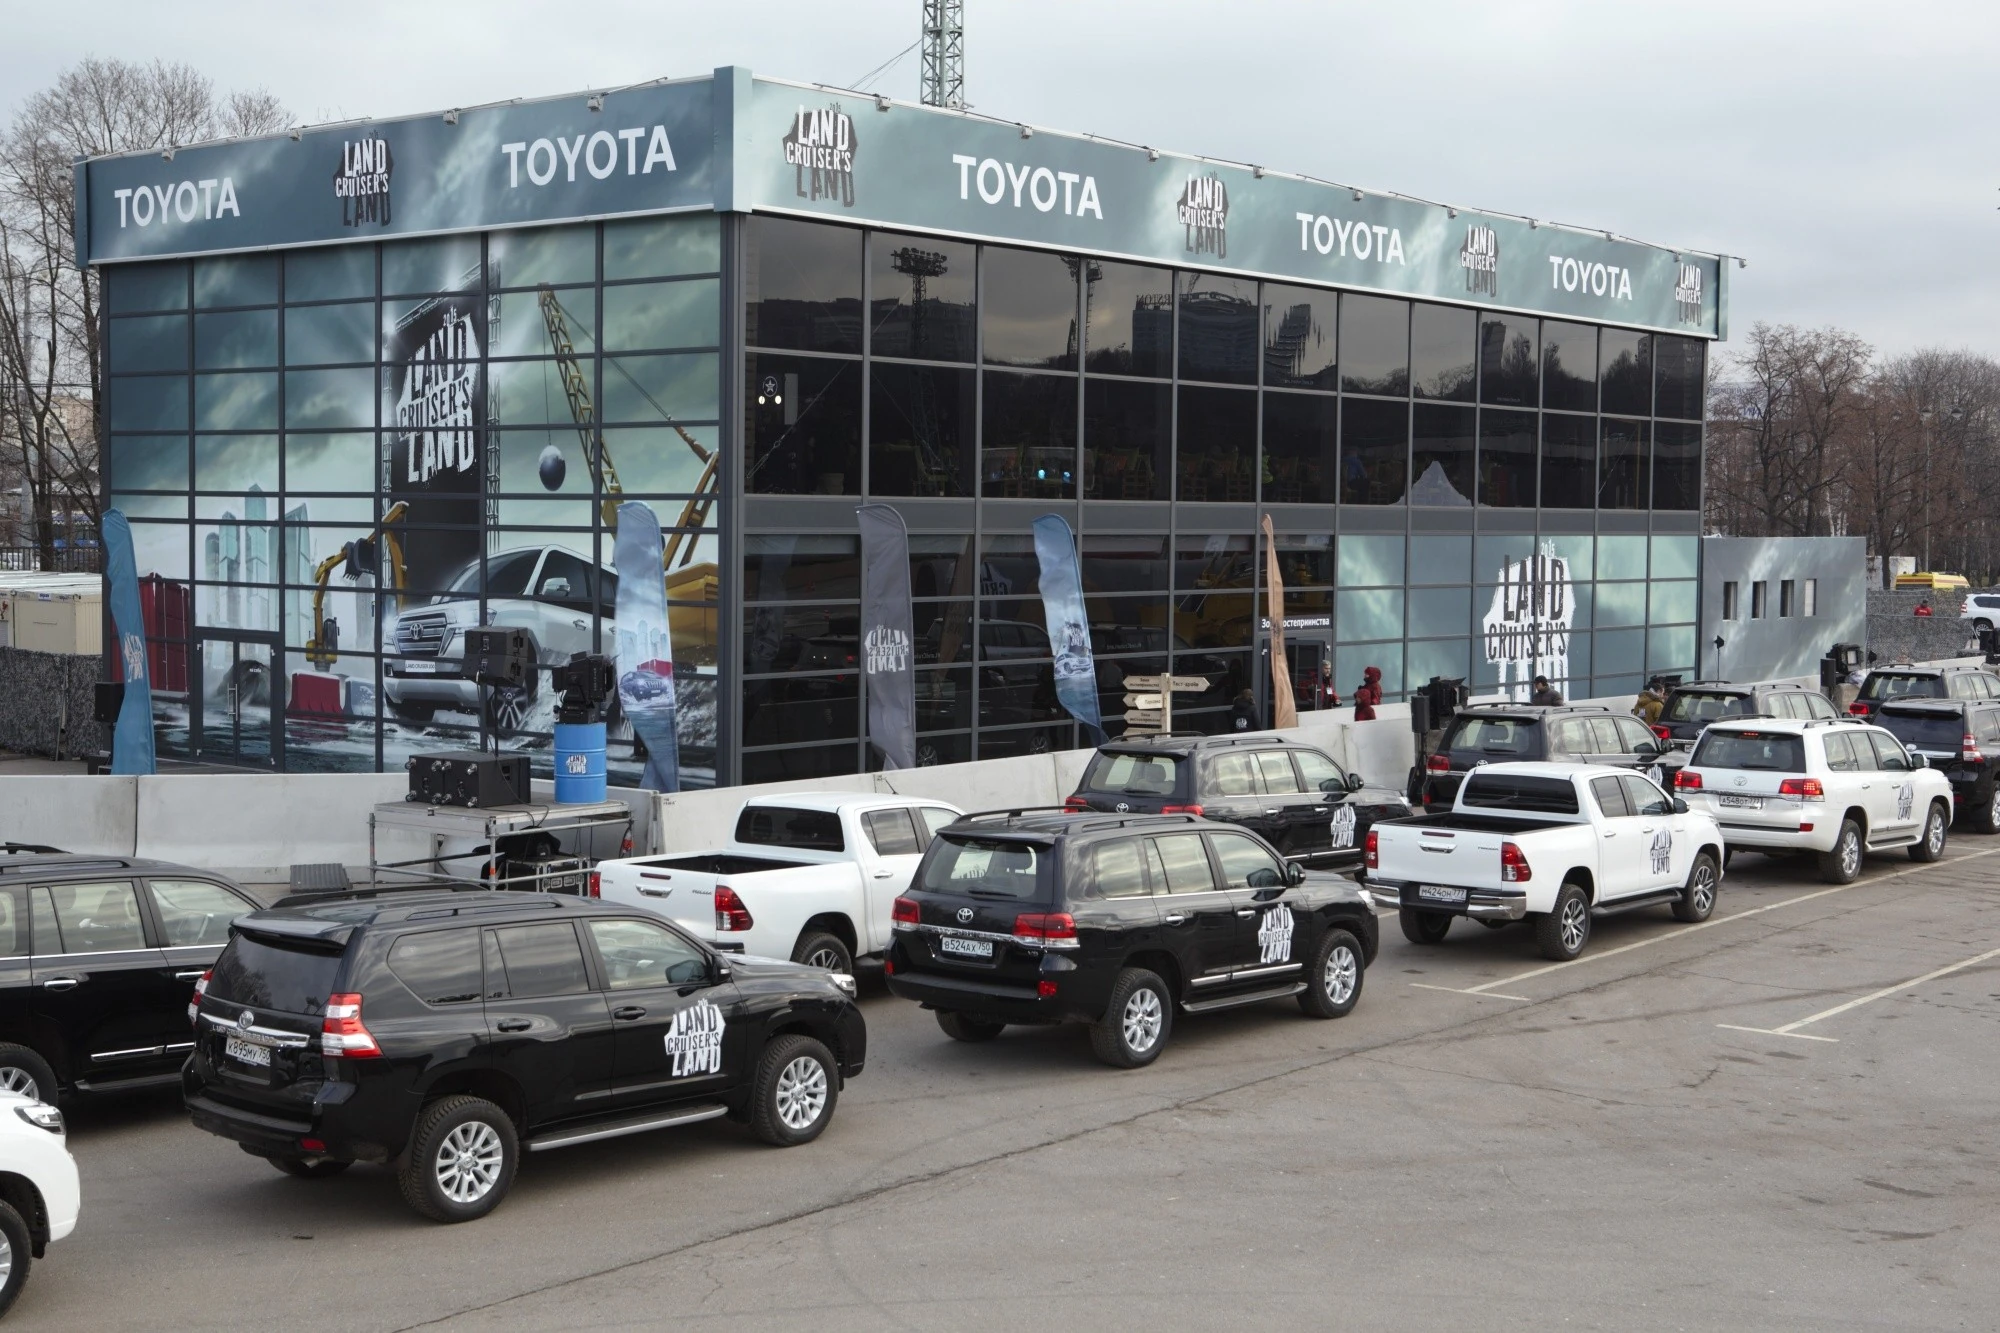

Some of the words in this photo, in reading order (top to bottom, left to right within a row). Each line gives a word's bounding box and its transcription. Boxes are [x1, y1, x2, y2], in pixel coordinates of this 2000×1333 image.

[798, 104, 849, 151] LAND
[344, 138, 386, 177] LAND
[502, 125, 677, 188] TOYOTA
[786, 142, 851, 172] CRUISER'S
[335, 173, 389, 198] CRUISER'S
[797, 164, 855, 207] LAND
[952, 154, 1104, 220] TOYOTA
[1187, 173, 1223, 211] LAND
[114, 177, 240, 228] TOYOTA
[343, 194, 392, 227] LAND
[1179, 205, 1225, 230] CRUISER'S
[1186, 223, 1227, 259] LAND
[1296, 211, 1405, 266] TOYOTA
[1467, 224, 1495, 257] LAND
[1461, 251, 1496, 272] CRUISER'S
[1549, 256, 1632, 300] TOYOTA
[1680, 262, 1701, 291] LAND
[1466, 267, 1496, 297] LAND
[443, 305, 457, 327] 2015
[411, 318, 467, 402] LAND
[400, 377, 470, 438] CRUISER'S
[407, 409, 475, 483] LAND
[1541, 538, 1555, 557] 2015
[1503, 554, 1564, 623] LAND
[1282, 617, 1330, 629] остеприимства
[1488, 620, 1567, 661] CRUISER'S
[1265, 908, 1289, 932] LAND
[1260, 942, 1291, 964] LAND
[676, 1005, 718, 1037] LAND
[667, 1031, 720, 1053] CRUISER'S
[672, 1048, 721, 1076] LAND
